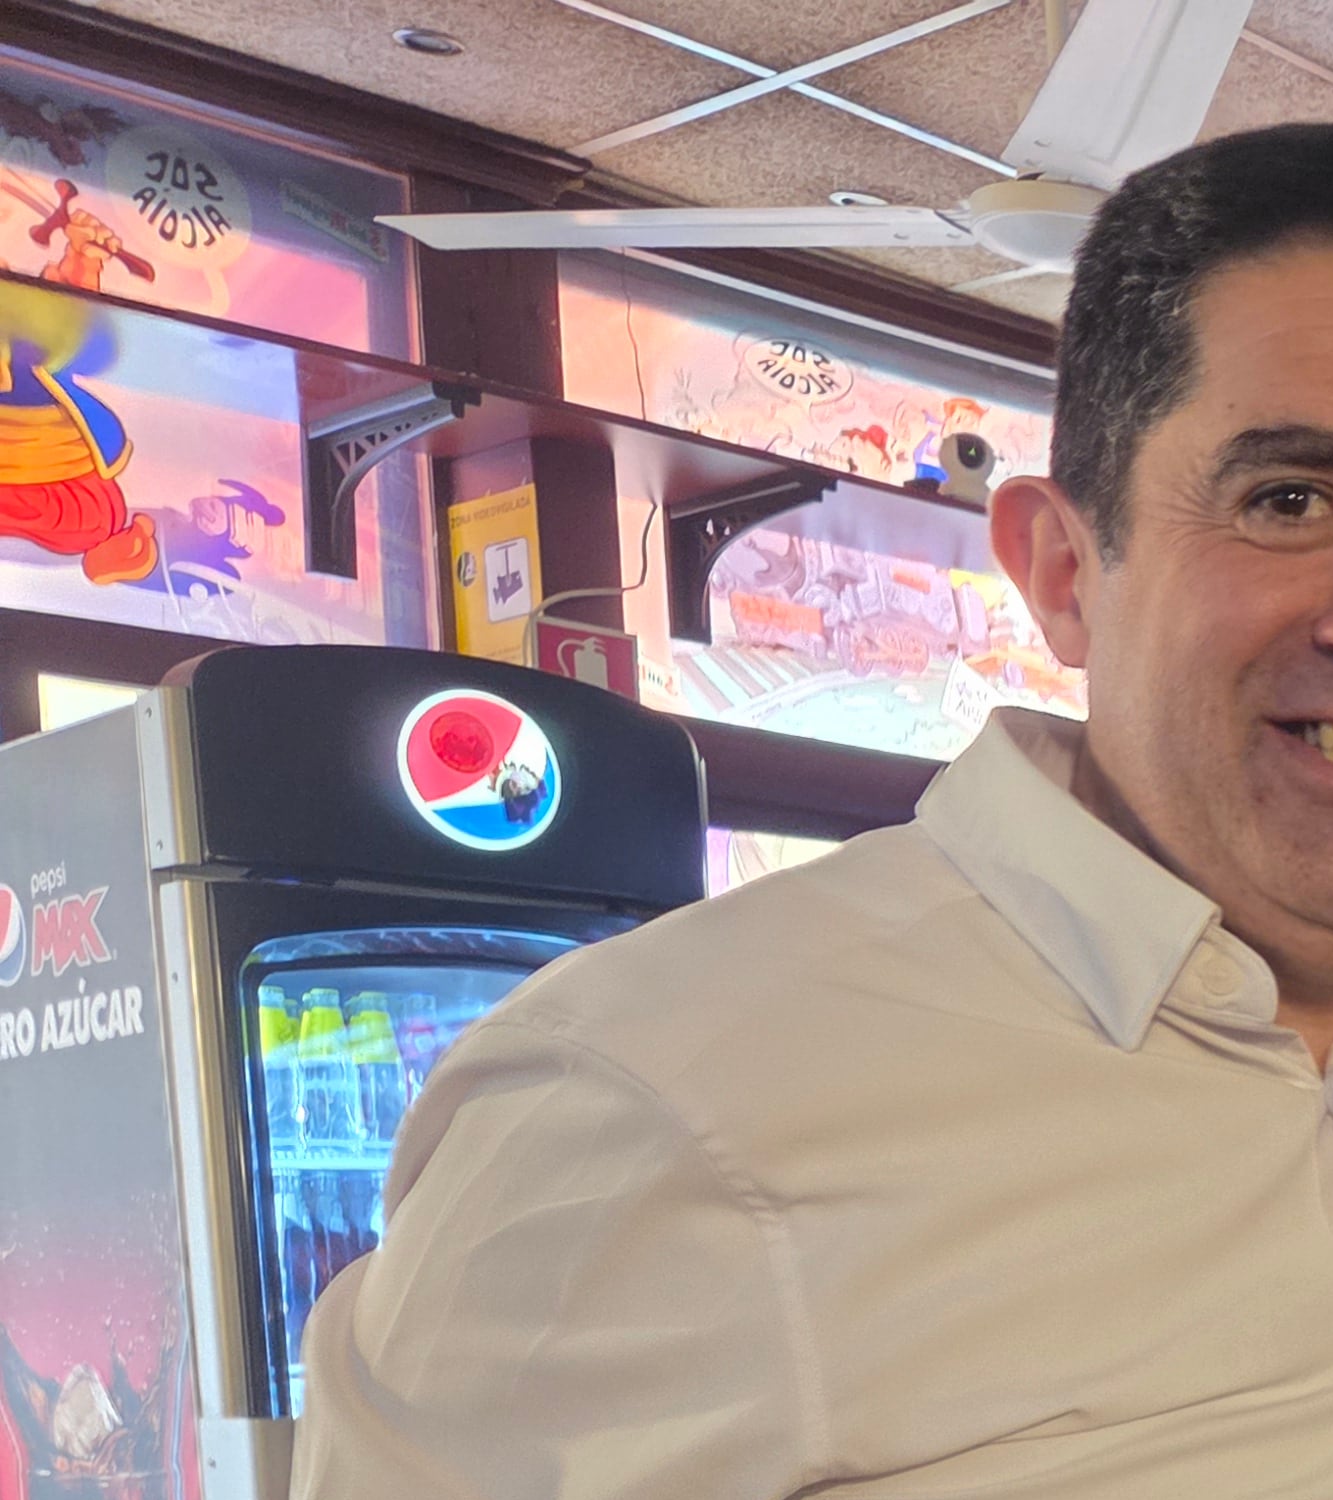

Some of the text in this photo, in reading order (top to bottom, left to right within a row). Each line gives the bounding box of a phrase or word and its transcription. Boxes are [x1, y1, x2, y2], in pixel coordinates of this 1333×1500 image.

[31, 860, 68, 899] pepsi
[31, 885, 112, 977] MAX
[0, 977, 145, 1060] RO AZÚCAR
